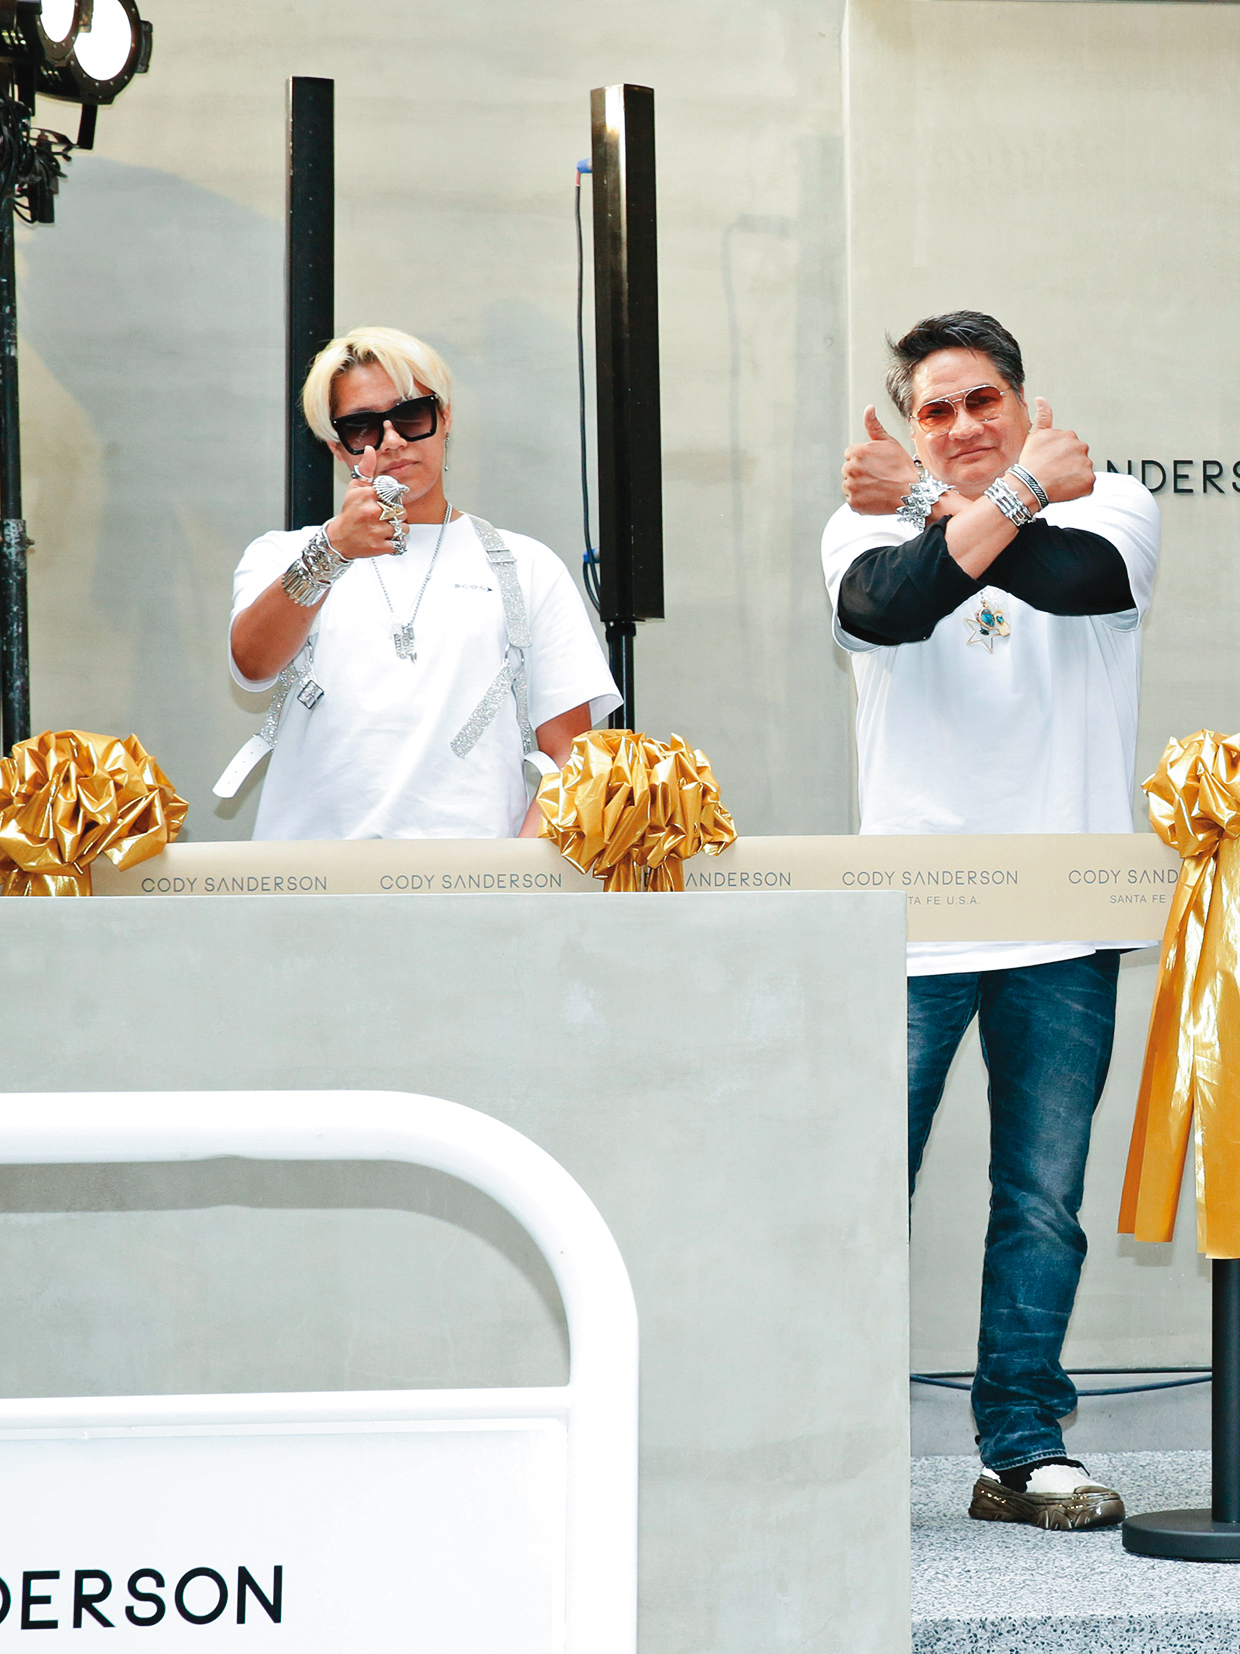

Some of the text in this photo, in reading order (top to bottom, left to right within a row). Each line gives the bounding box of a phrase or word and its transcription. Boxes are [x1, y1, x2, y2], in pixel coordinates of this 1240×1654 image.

[140, 875, 328, 893] CODY SANDERSON
[379, 872, 562, 890] CODY SANDERSON
[685, 871, 791, 887] ANDERSON
[841, 870, 1018, 886] CODY SANDERSON
[1068, 869, 1179, 885] CODY SAND
[926, 895, 941, 906] FE
[946, 895, 981, 906] U.S.A.
[1109, 894, 1166, 904] SANTA FE
[0, 1564, 283, 1631] ERSON
